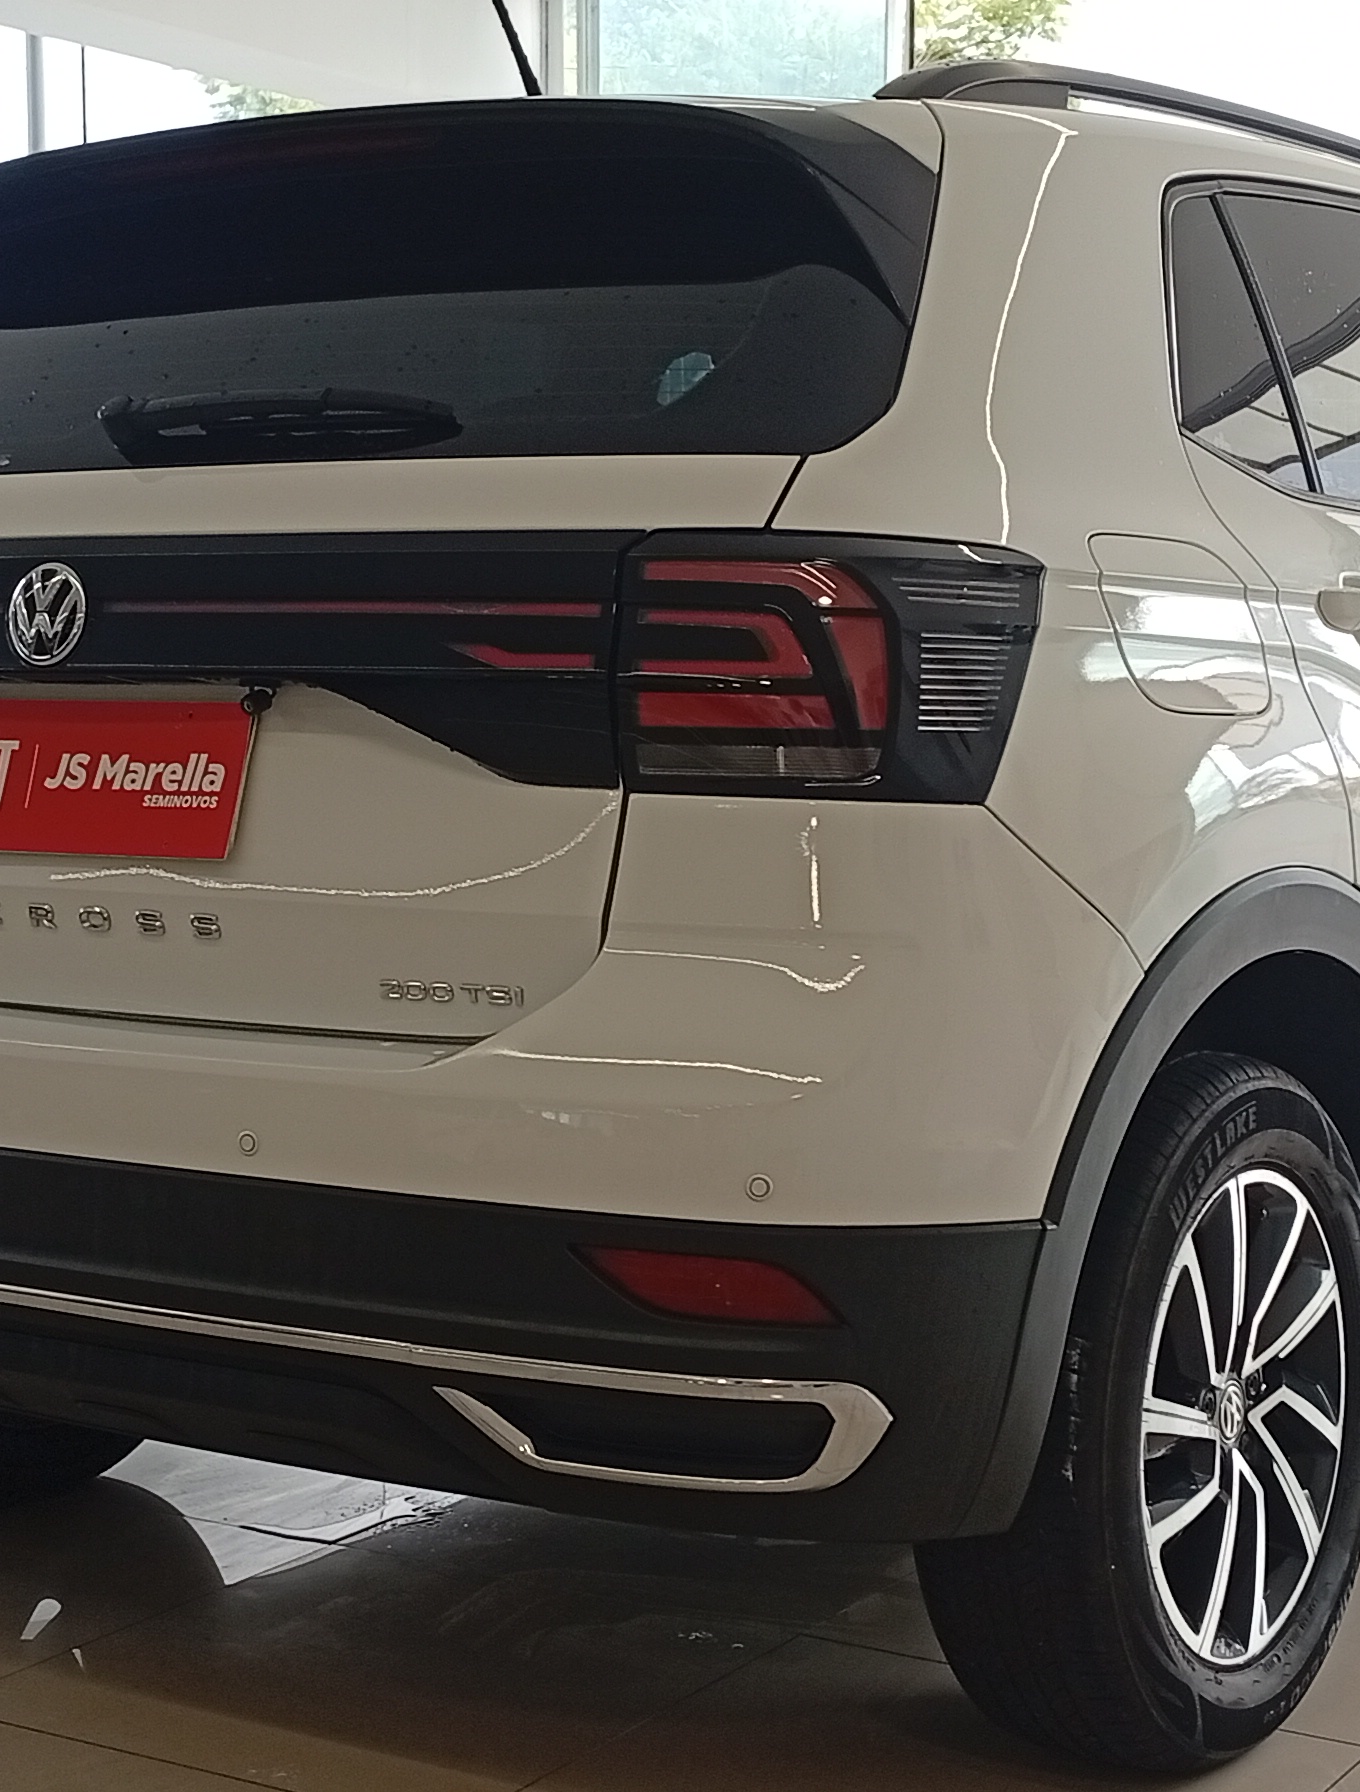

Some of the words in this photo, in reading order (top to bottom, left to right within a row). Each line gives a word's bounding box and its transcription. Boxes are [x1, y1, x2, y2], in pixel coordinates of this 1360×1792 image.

[43, 752, 91, 791] JS
[93, 752, 226, 793] Marella
[142, 794, 219, 809] SEMINOVOS
[379, 978, 455, 1003] 200
[459, 982, 525, 1007] TSI
[1169, 1104, 1258, 1231] WESTLAKE
